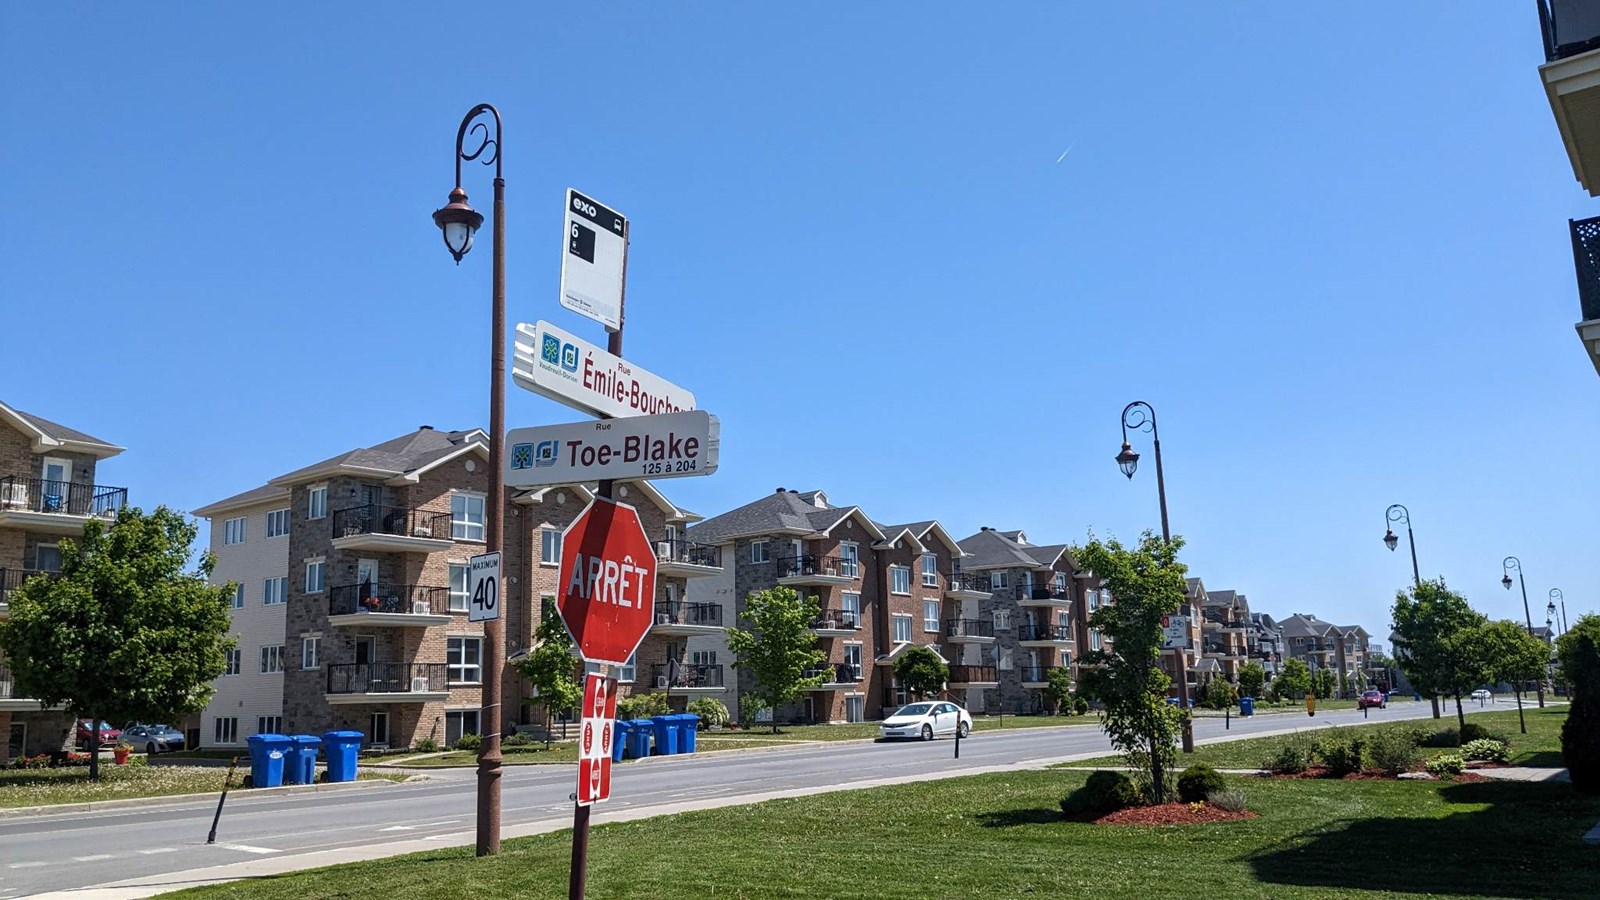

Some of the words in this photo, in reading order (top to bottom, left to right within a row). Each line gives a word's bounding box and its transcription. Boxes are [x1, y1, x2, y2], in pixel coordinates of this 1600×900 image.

[573, 197, 597, 218] exo
[571, 223, 579, 238] 6
[539, 361, 578, 383] Vaudreuil-Dorion
[617, 362, 631, 376] Rue
[583, 351, 693, 415] Émile-Bouch
[596, 423, 612, 431] Rue
[567, 432, 699, 467] Toe-Blake
[642, 462, 661, 475] 125
[665, 462, 672, 473] à
[677, 459, 696, 472] 204
[472, 559, 499, 571] MAXIMUM
[568, 553, 648, 610] ARRÊT
[473, 576, 496, 611] 40
